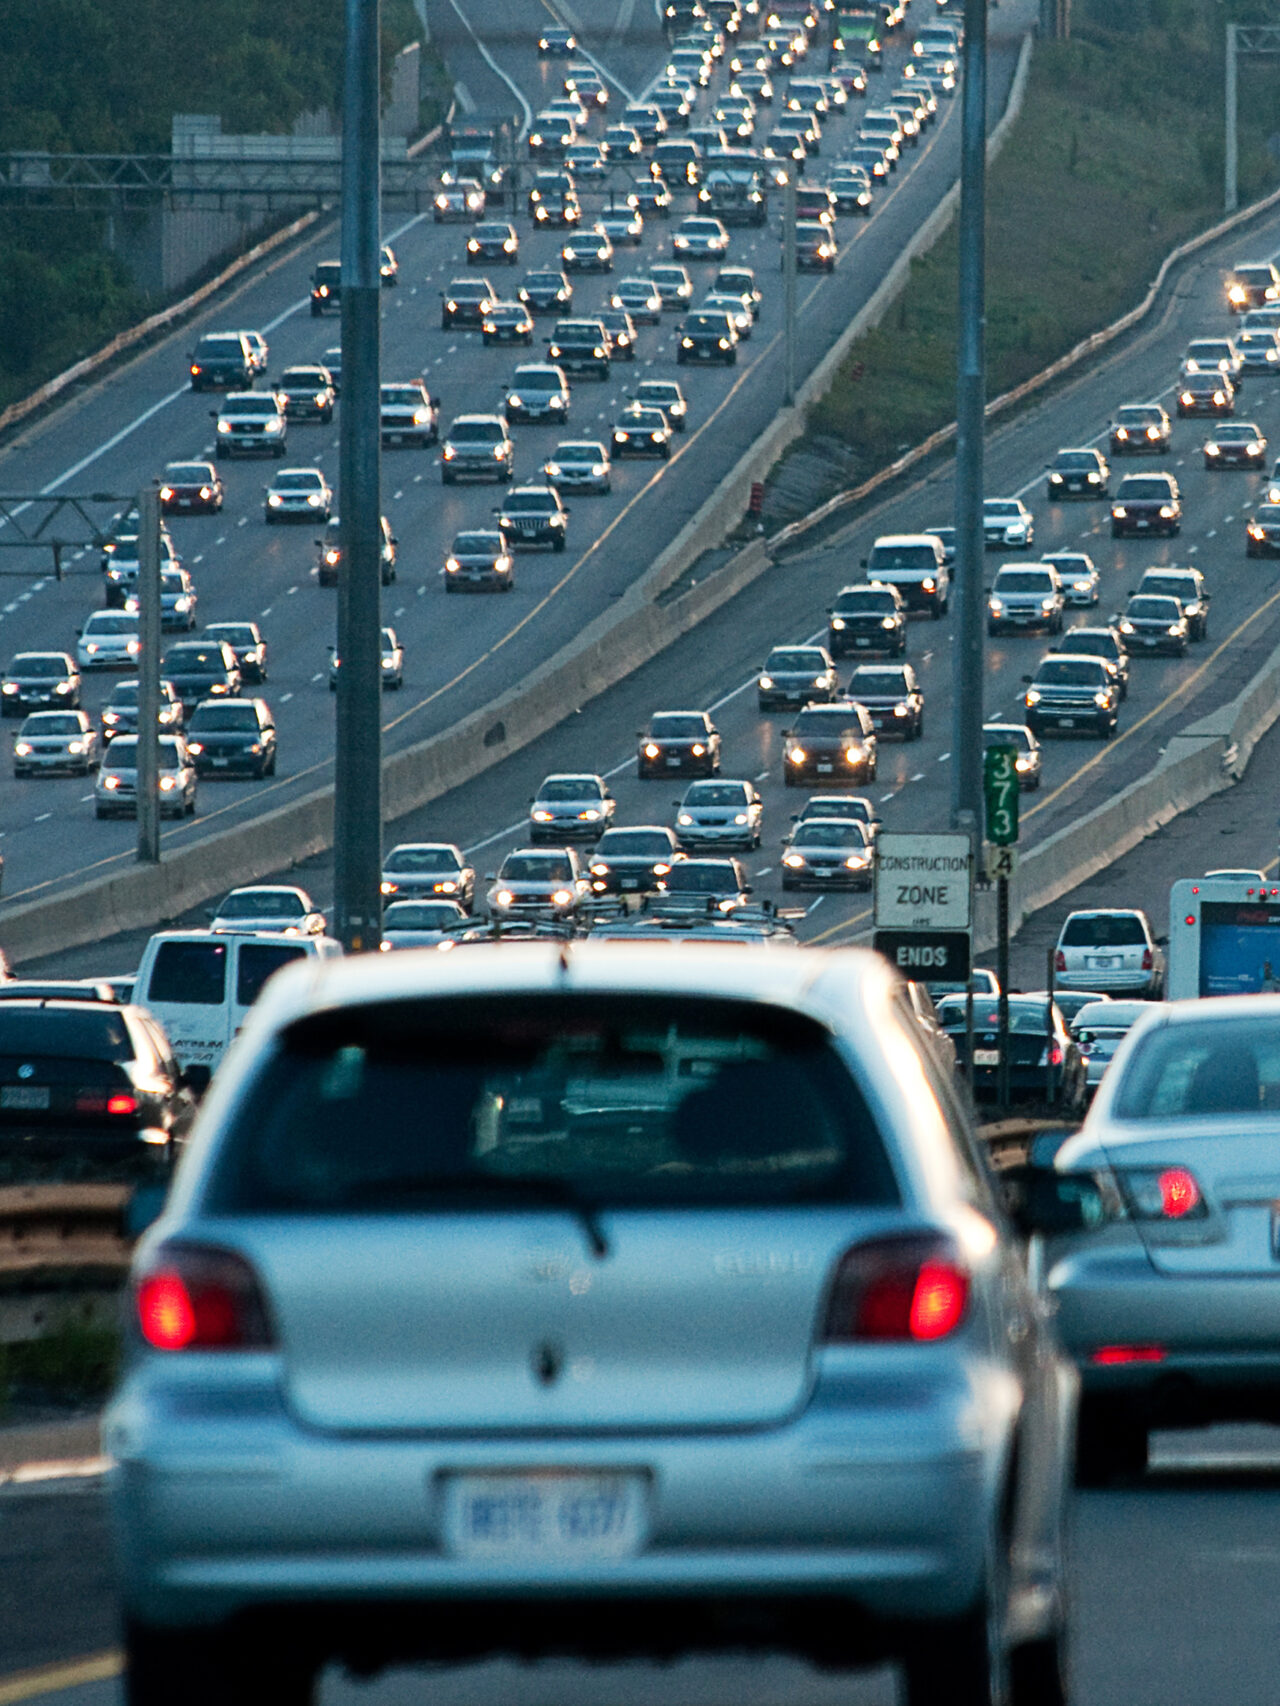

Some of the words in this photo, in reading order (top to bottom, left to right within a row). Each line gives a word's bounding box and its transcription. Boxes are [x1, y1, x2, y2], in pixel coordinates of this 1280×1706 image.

[879, 855, 968, 872] CONSTRUCTION
[896, 886, 948, 905] ZONE
[896, 946, 948, 967] ENDS
